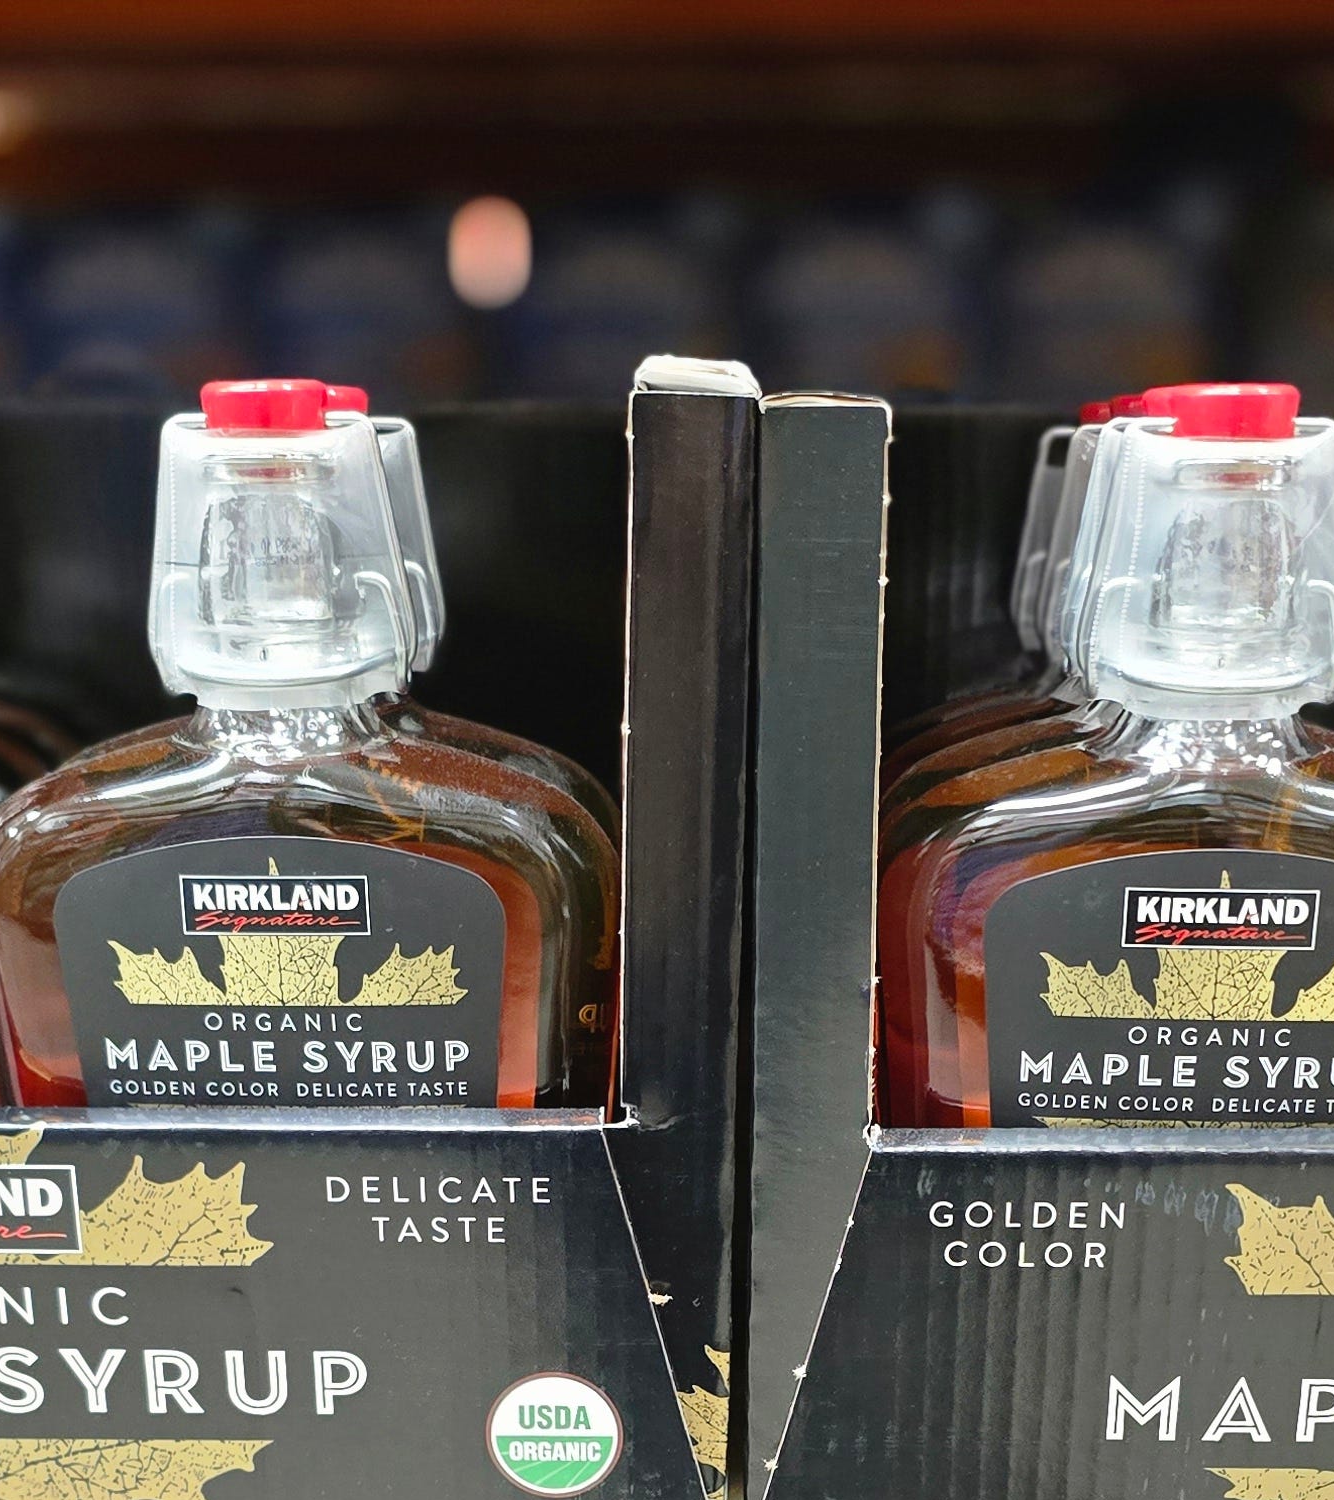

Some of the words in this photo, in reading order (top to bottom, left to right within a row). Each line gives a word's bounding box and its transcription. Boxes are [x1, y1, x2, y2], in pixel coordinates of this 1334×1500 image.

[192, 883, 359, 911] KIRKLAND
[1137, 896, 1309, 925] KIRKLAND
[195, 912, 360, 932] Signature
[1135, 923, 1306, 945] Signature
[204, 1013, 364, 1032] ORGANIC
[1127, 1026, 1292, 1047] ORGANIC
[106, 1039, 274, 1073] MAPLE
[303, 1041, 470, 1073] SYRUP
[1020, 1051, 1197, 1088] MAPLE
[109, 1080, 195, 1097] GOLDEN
[206, 1081, 279, 1097] COLOR
[297, 1082, 397, 1098] DELICATE
[408, 1080, 468, 1097] TASTE
[1018, 1093, 1108, 1110] GOLDEN
[1119, 1096, 1193, 1112] COLOR
[1212, 1097, 1315, 1115] DELICATE
[326, 1176, 552, 1204] DELICATE
[929, 1202, 1125, 1230] GOLDEN
[372, 1217, 506, 1243] TASTE
[944, 1241, 1105, 1269] COLOR
[518, 1403, 591, 1431] USDA
[507, 1438, 602, 1465] ORGANIC
